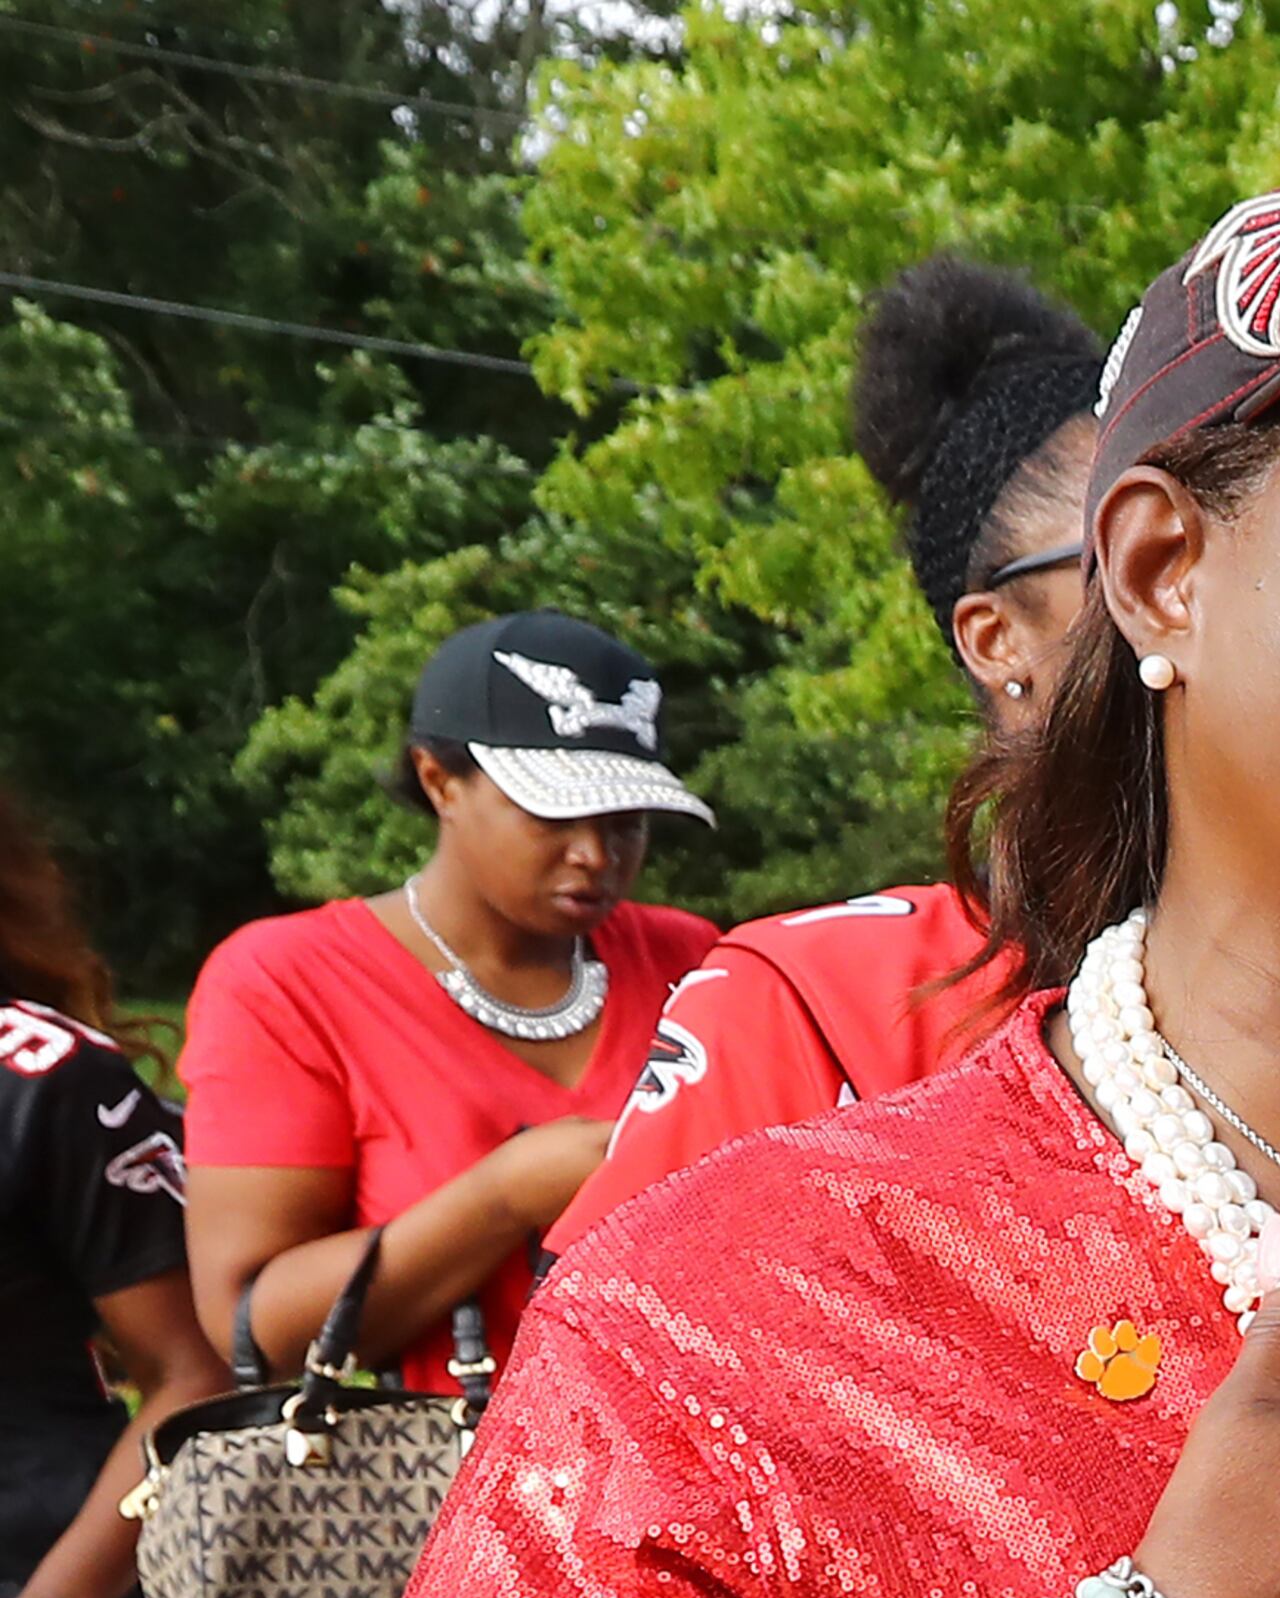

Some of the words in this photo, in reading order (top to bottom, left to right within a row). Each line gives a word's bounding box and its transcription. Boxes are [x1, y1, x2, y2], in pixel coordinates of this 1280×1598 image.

[359, 1420, 417, 1446] MK
[326, 1452, 382, 1480] MK
[393, 1451, 450, 1479] MK
[224, 1485, 281, 1513] MK
[291, 1485, 349, 1513] MK
[360, 1486, 417, 1513] MK
[257, 1519, 313, 1548] MK
[325, 1519, 383, 1547] MK
[393, 1519, 429, 1547] M
[224, 1553, 278, 1583] MK
[287, 1553, 349, 1581] MK
[357, 1552, 412, 1580] MK
